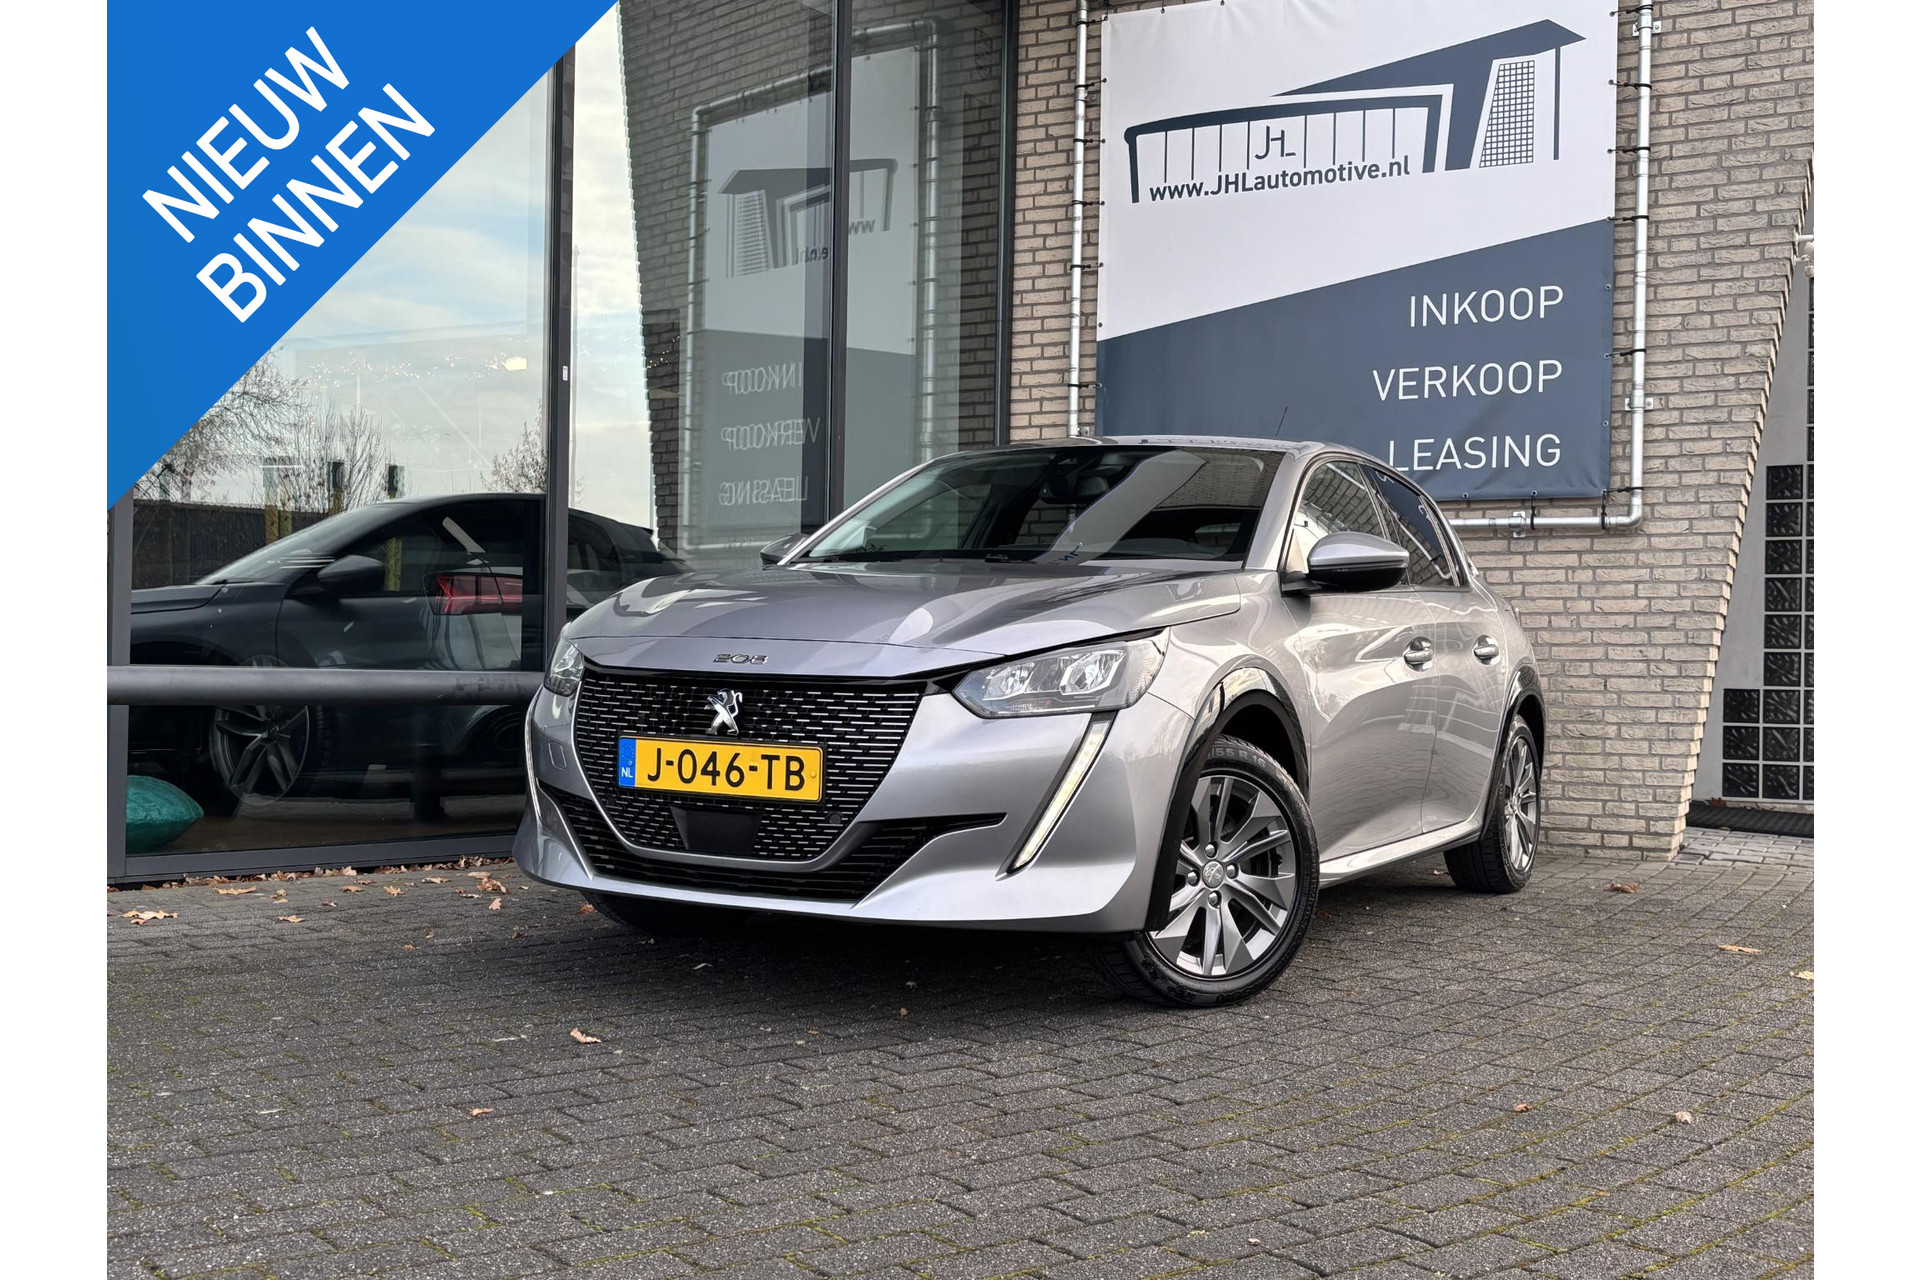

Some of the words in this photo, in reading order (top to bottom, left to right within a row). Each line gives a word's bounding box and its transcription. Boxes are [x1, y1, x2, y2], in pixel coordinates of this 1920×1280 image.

[1254, 125, 1297, 160] JHL
[1149, 155, 1411, 202] www.JHLautomotive.nl
[1410, 285, 1564, 328] INKOOP
[1372, 359, 1563, 401] VERKOOP
[1389, 433, 1561, 472] LEASING
[712, 653, 768, 665] 208
[621, 766, 633, 779] NL
[647, 747, 805, 791] J-046-TB
